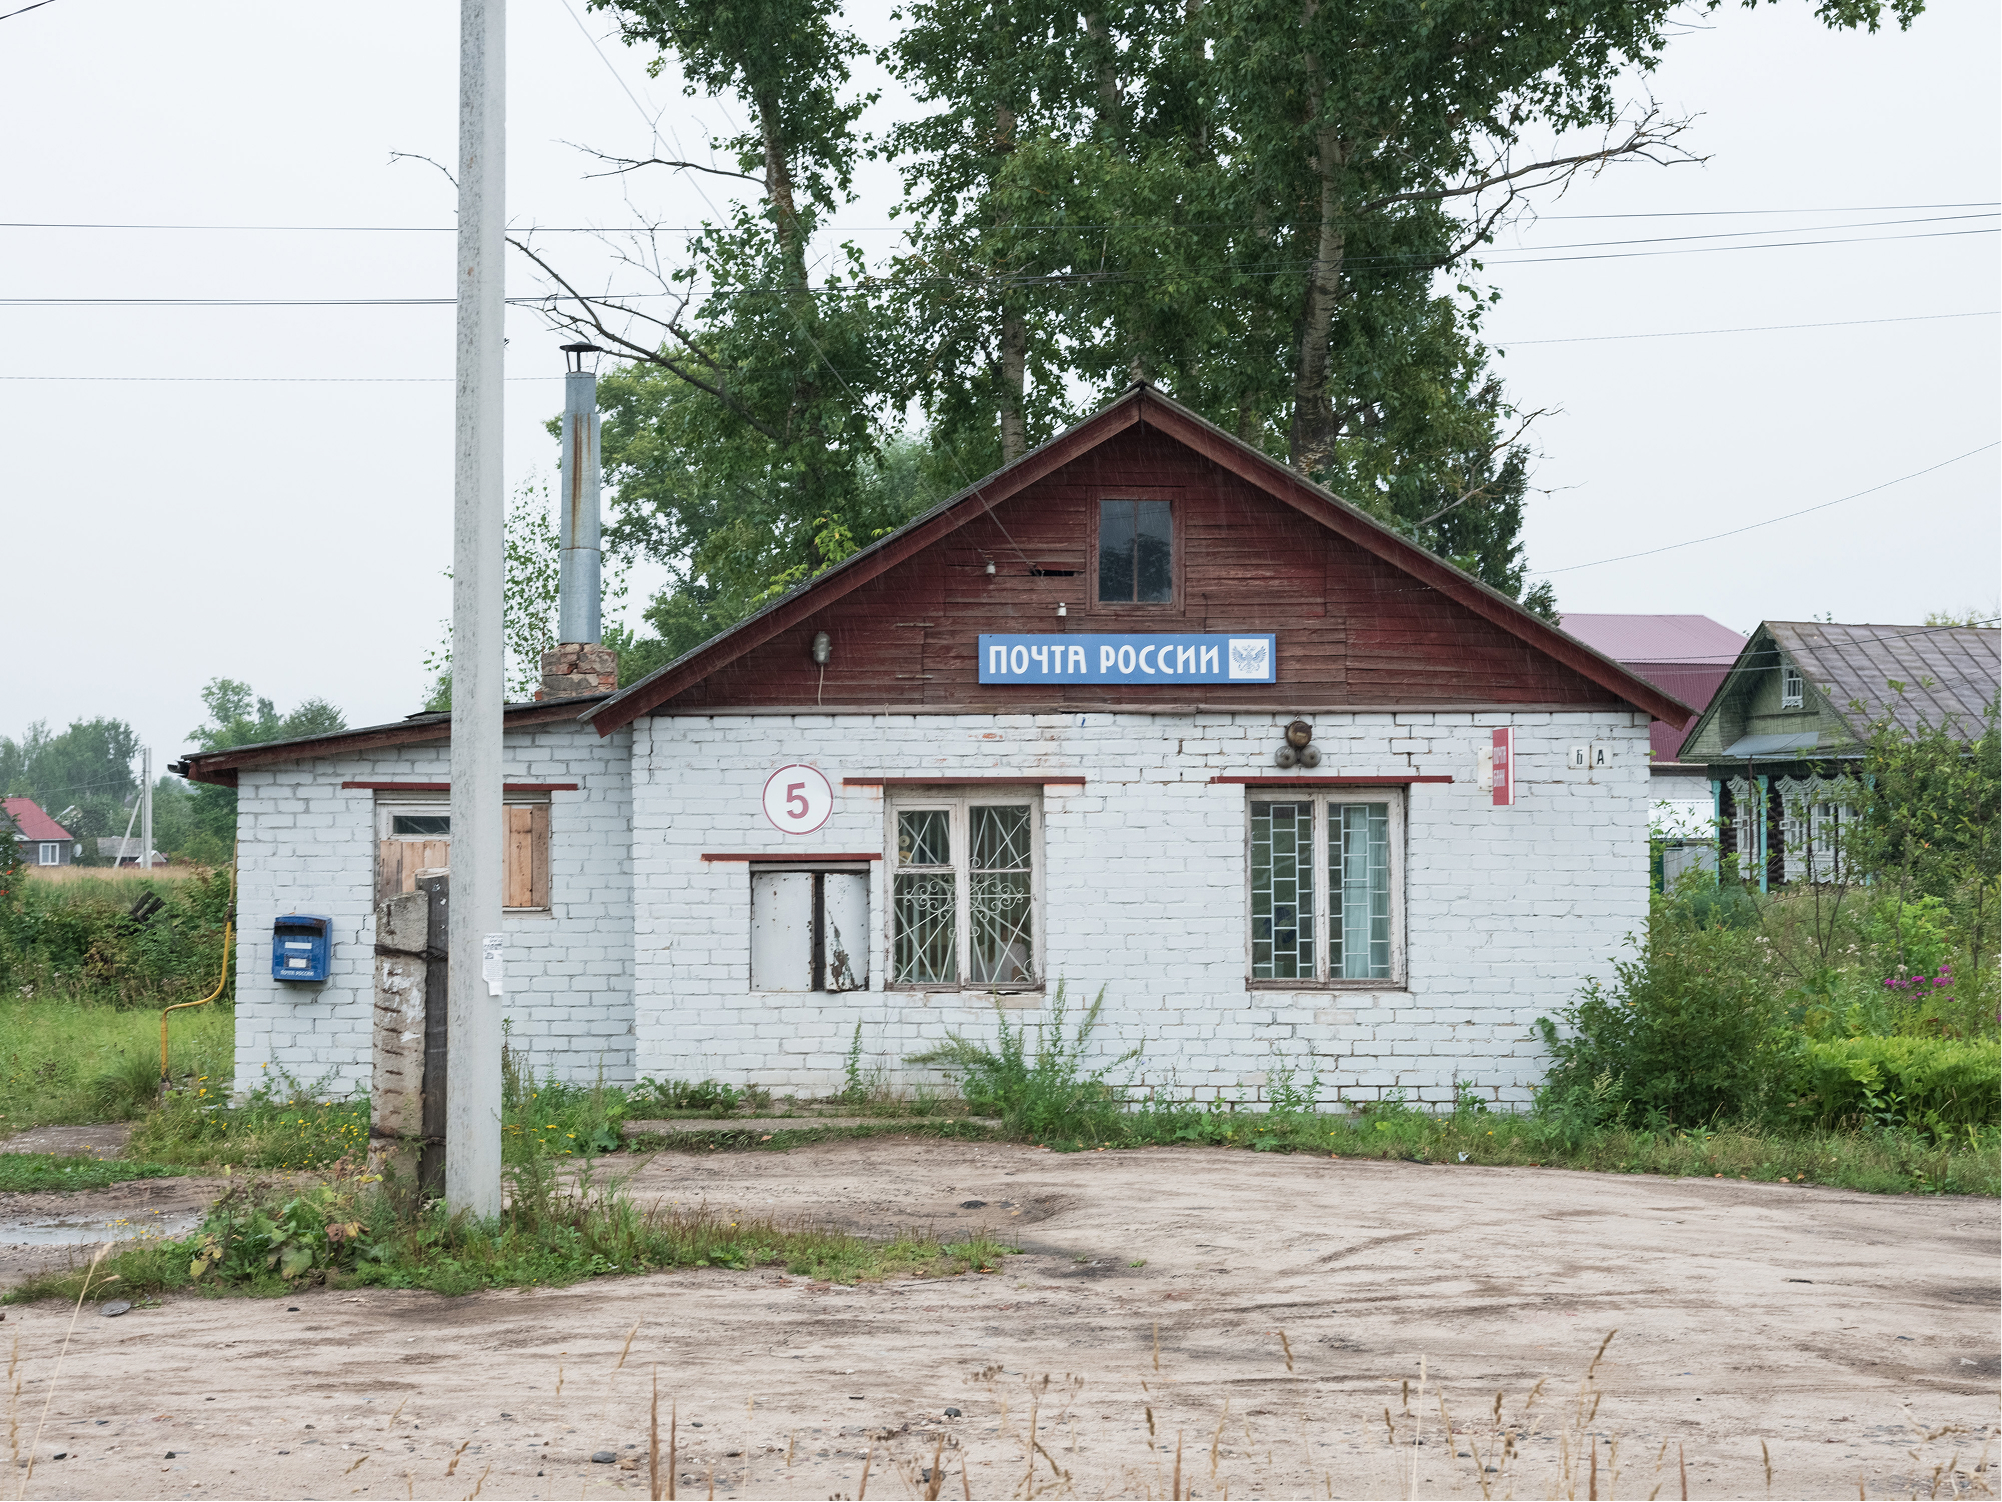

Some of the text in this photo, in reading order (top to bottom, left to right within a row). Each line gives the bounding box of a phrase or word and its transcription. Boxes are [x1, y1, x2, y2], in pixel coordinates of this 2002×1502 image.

[989, 645, 1220, 674] ПОЧТА РОССИИ
[786, 782, 809, 819] 5
